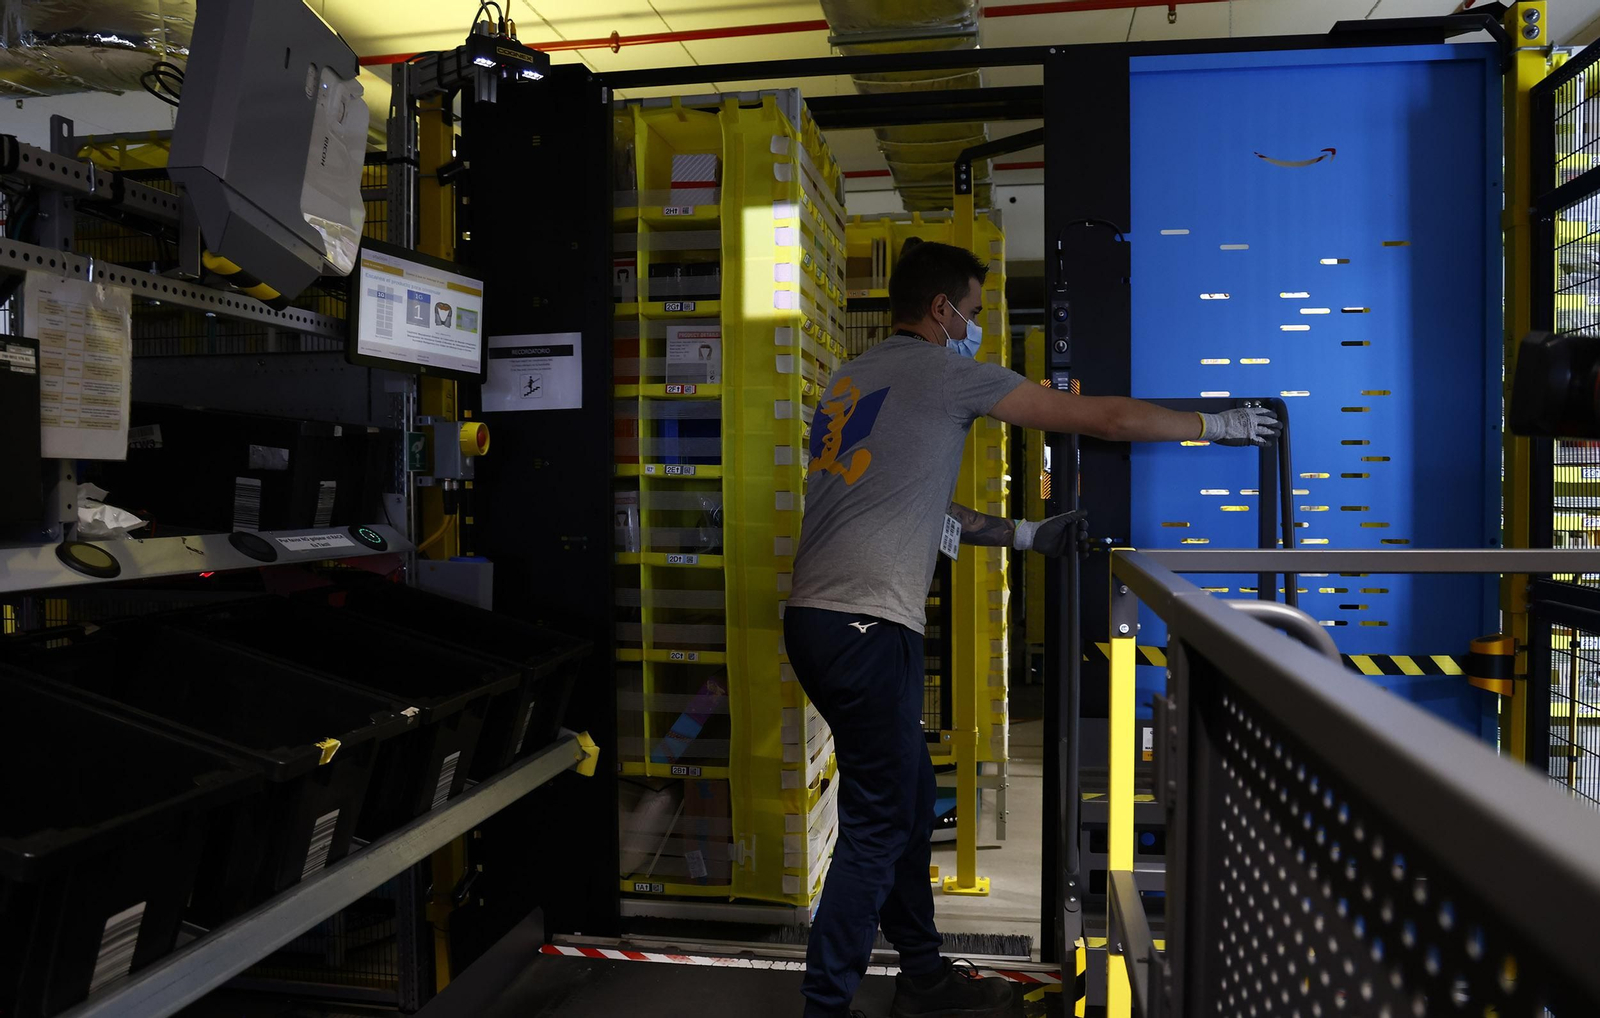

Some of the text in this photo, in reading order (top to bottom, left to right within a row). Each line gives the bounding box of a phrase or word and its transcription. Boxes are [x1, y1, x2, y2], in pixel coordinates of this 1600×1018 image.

[497, 47, 533, 61] COGNEX
[320, 136, 329, 167] RICOH
[414, 304, 423, 320] 1
[666, 303, 676, 311] 2G
[511, 347, 551, 355] RECORDATORIO
